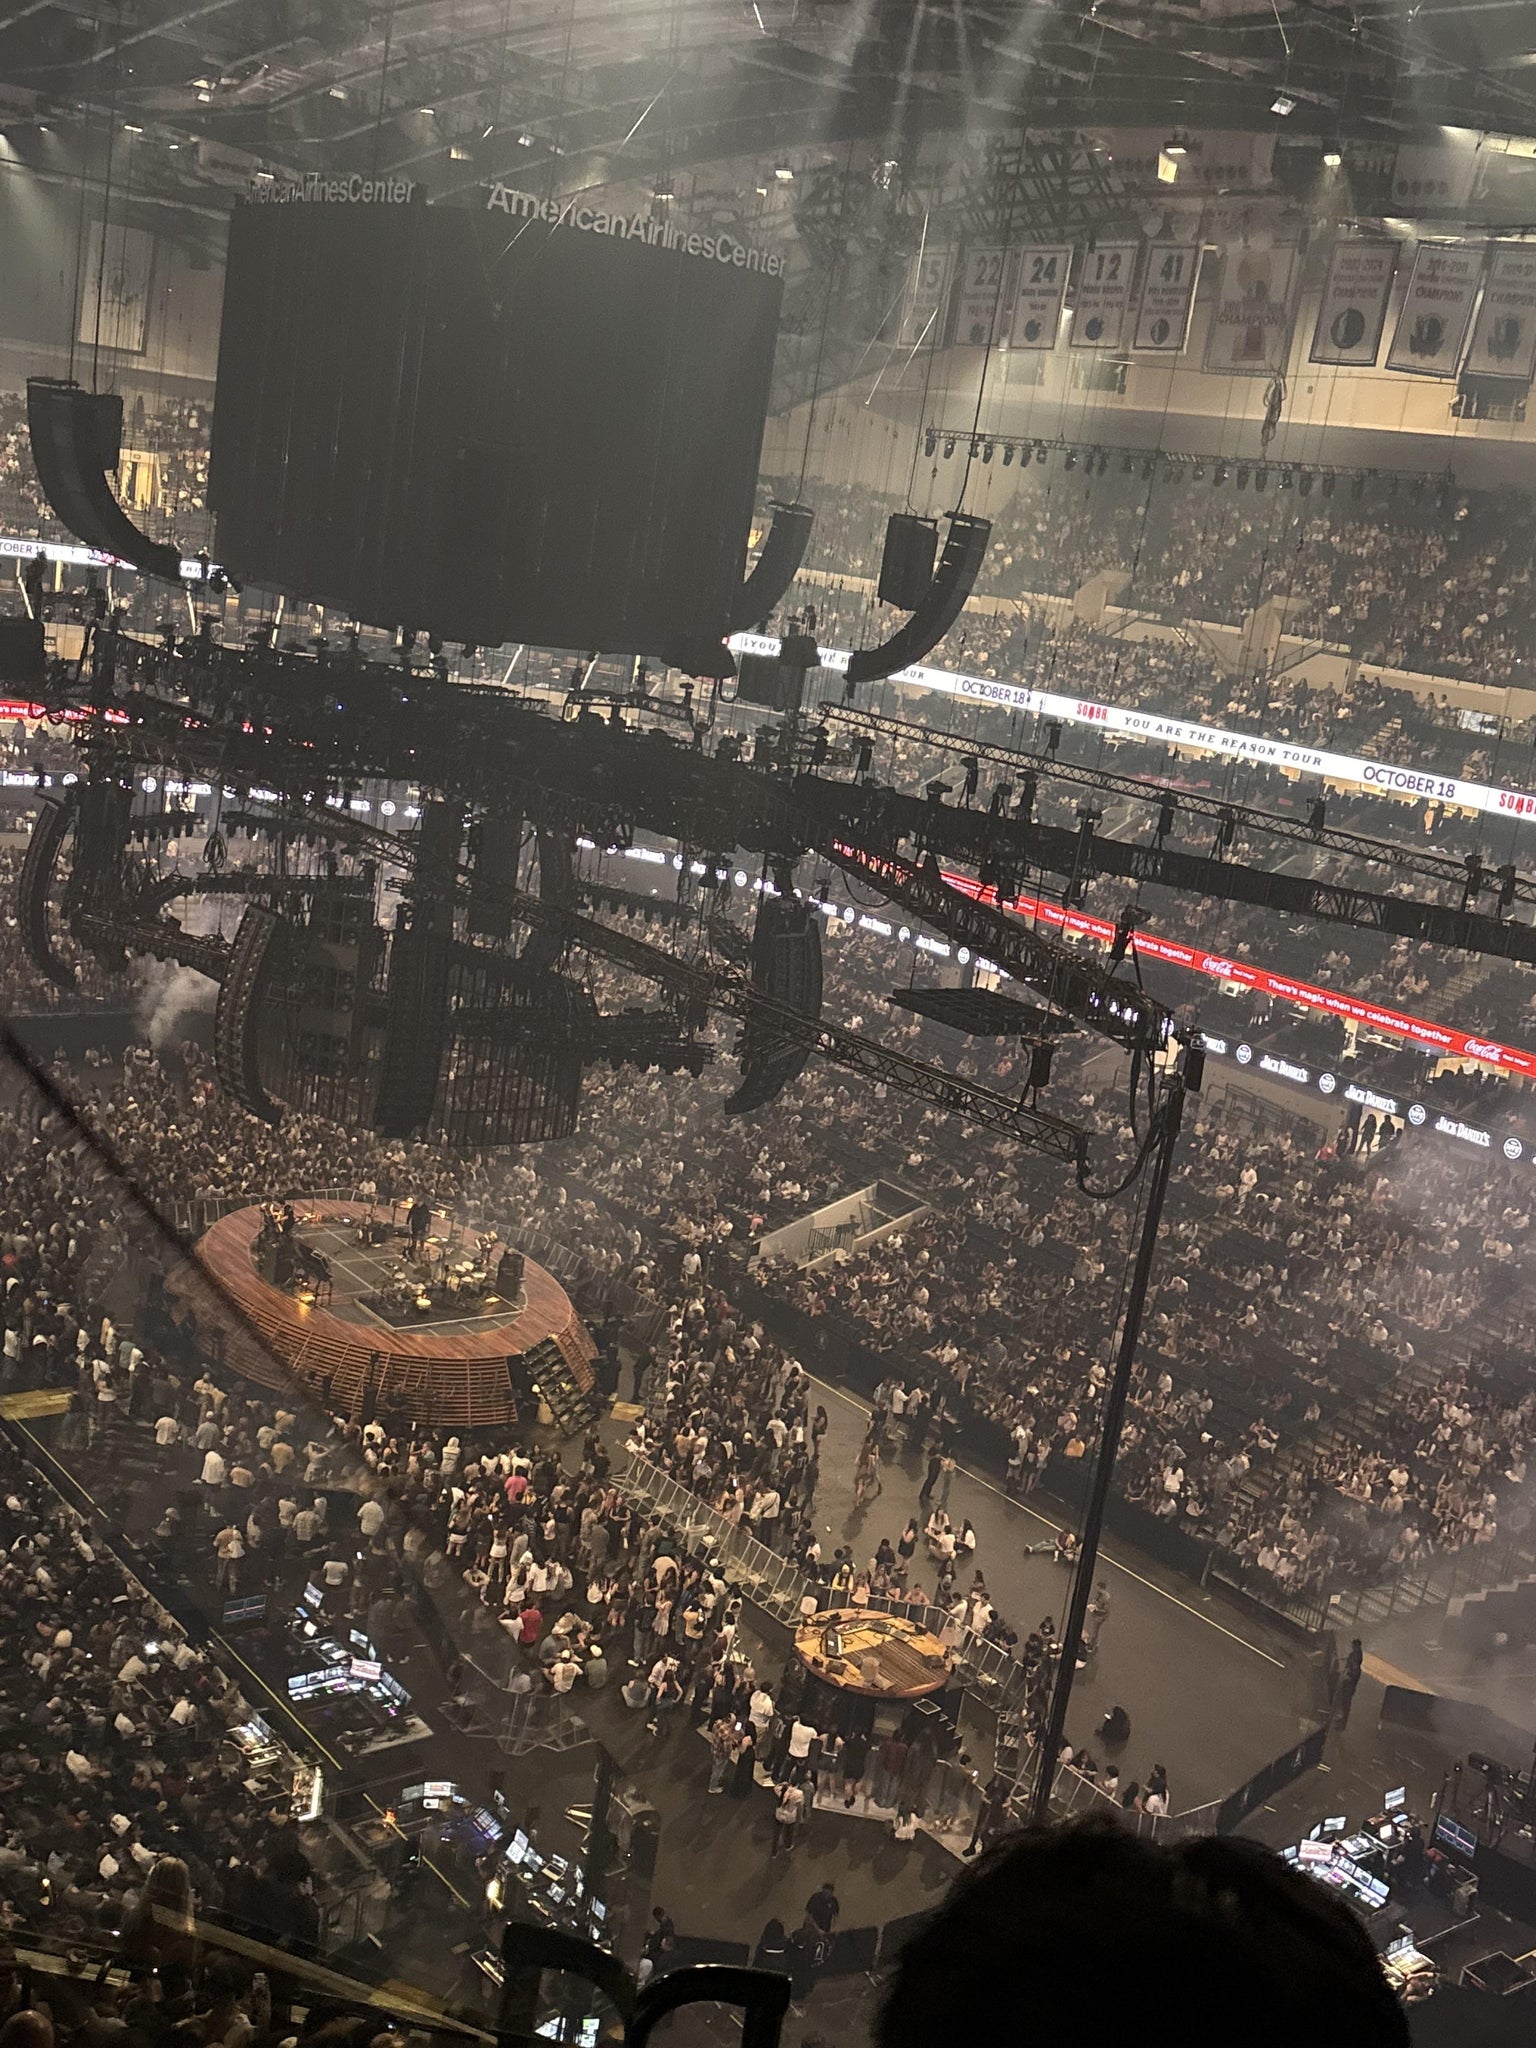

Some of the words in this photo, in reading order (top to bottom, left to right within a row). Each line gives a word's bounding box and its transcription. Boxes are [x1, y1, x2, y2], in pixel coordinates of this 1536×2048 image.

[487, 182, 787, 278] AmericanAirlinesCenter
[974, 255, 1000, 286] 22
[1029, 256, 1058, 284] 24
[1095, 253, 1121, 281] 12
[1160, 254, 1183, 282] 41
[0, 542, 33, 555] TOBER
[961, 679, 1011, 700] OCTOBER
[1012, 691, 1025, 704] 18
[1124, 716, 1150, 729] YOU
[1155, 723, 1183, 737] ARE
[1189, 730, 1215, 744] THE
[1221, 737, 1276, 756] REASON
[1283, 750, 1322, 766] TOUR
[1363, 766, 1435, 795] OCTOBER
[1437, 782, 1456, 798] 18
[1499, 792, 1536, 815] SOMB
[1091, 923, 1111, 937] when
[1160, 945, 1193, 962] together
[1268, 978, 1297, 995] There's
[1299, 989, 1325, 1005] magic
[1326, 997, 1350, 1012] when
[1352, 1006, 1365, 1016] we
[1367, 1010, 1409, 1031] celebrate
[1411, 1024, 1453, 1044] together
[1344, 1084, 1366, 1104] JACK
[1365, 1090, 1397, 1114] DANIEL'S
[1435, 1116, 1458, 1137] JACK
[1457, 1122, 1491, 1147] DANIEL'S
